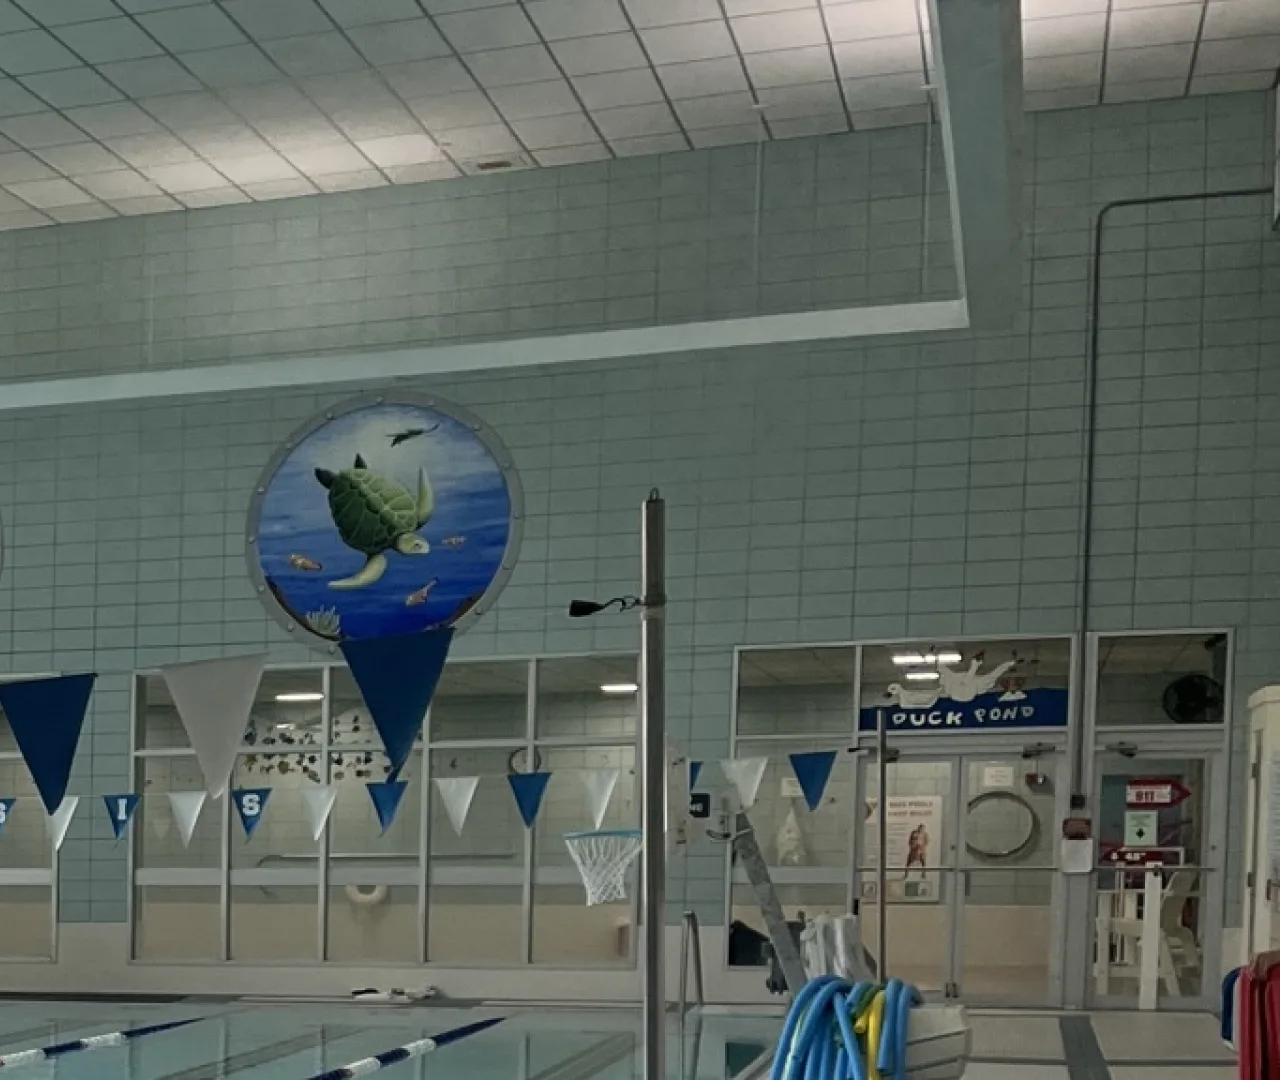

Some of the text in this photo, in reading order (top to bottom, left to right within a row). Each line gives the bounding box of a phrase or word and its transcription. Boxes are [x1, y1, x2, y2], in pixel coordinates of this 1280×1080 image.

[891, 705, 1035, 726] DUCK POND
[116, 798, 128, 820] I
[242, 794, 261, 816] S
